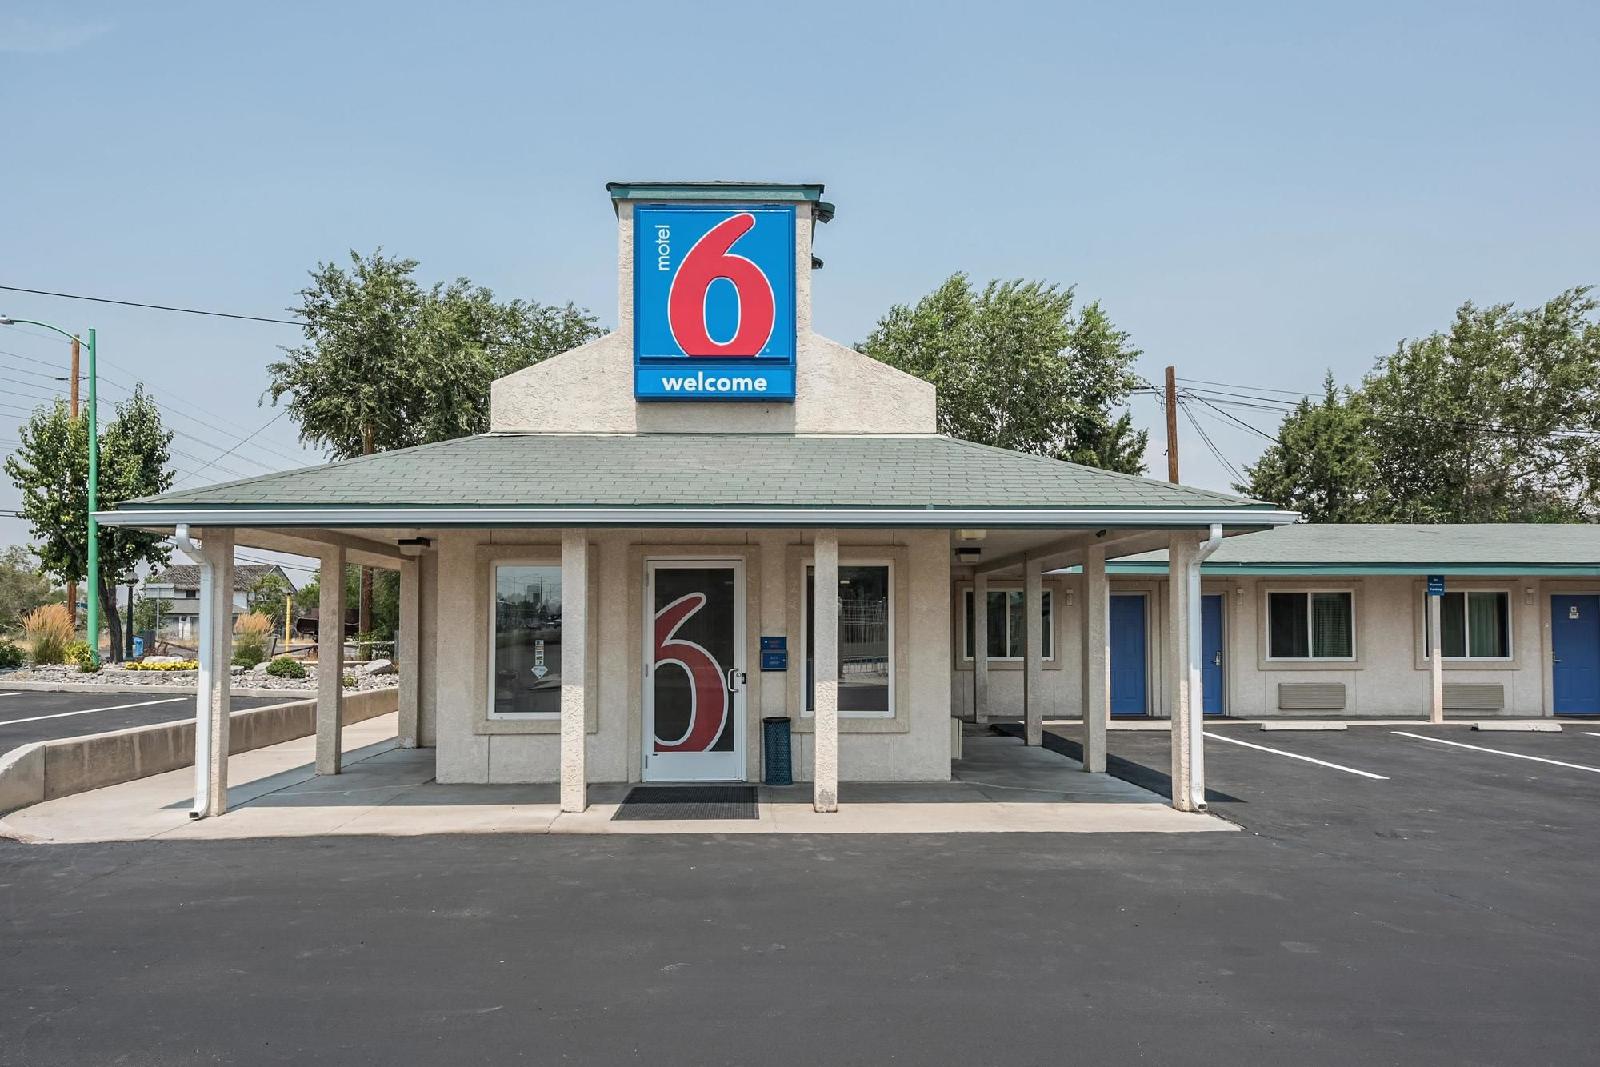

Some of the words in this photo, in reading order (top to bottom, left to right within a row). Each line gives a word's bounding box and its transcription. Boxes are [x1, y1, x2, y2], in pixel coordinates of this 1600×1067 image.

[655, 225, 670, 271] motel
[668, 212, 776, 357] 6
[661, 371, 768, 391] welcome
[654, 592, 729, 752] 6
